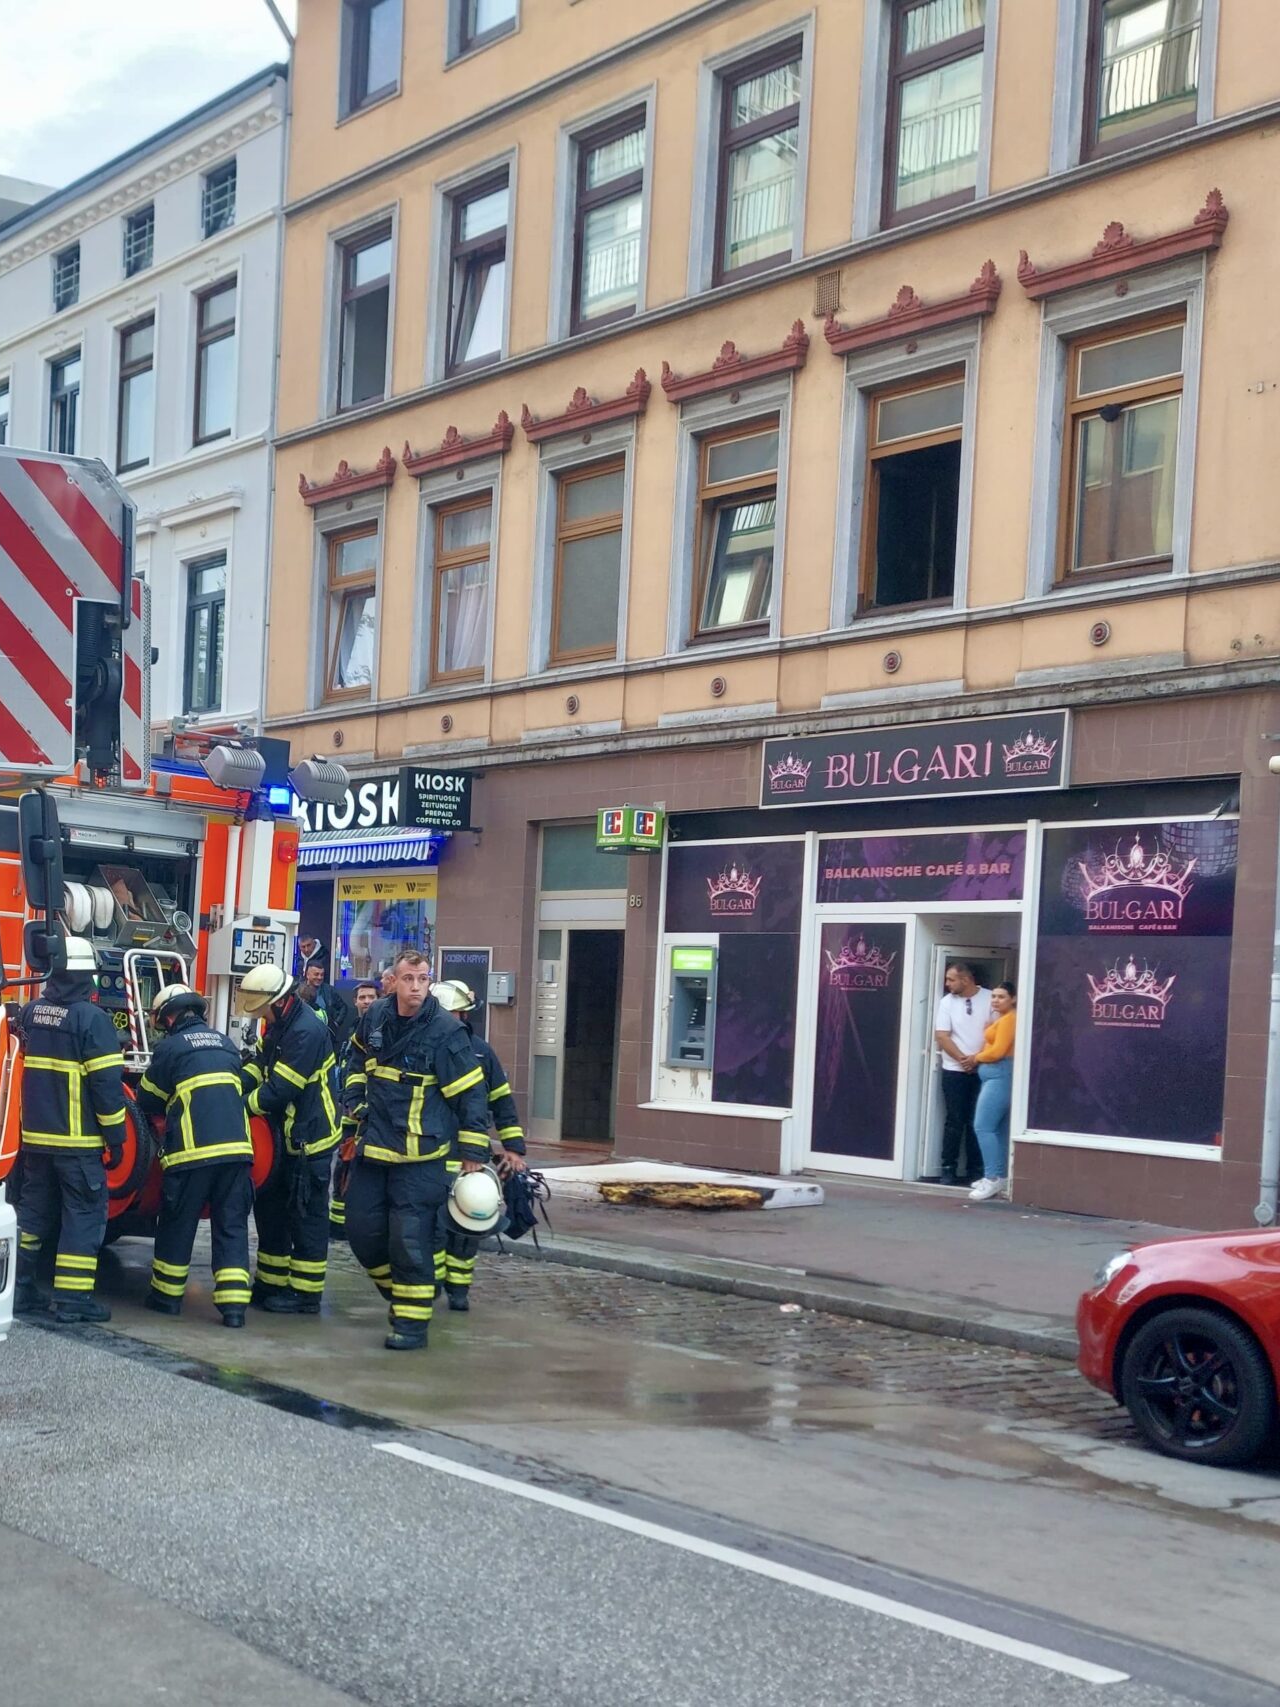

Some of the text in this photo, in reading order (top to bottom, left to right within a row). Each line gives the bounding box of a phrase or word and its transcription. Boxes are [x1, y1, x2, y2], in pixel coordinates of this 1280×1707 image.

[823, 739, 993, 789] BULGARI
[414, 773, 465, 793] KIOSK
[418, 793, 461, 802] SPIRITUOSEN
[421, 801, 458, 810] ZEITUNGEN
[415, 816, 440, 825] COFFEE
[825, 861, 1011, 879] BALKANISCHE CAFÉ & BAR
[629, 895, 642, 907] 86
[1085, 900, 1183, 920] BULGARI
[252, 934, 269, 950] HH
[243, 949, 275, 965] 2505
[32, 1004, 69, 1018] FEUERWEHR
[1091, 1003, 1165, 1020] BULGARI
[32, 1014, 62, 1026] HAMBURG
[183, 1032, 223, 1042] FEUERWEHR
[190, 1039, 223, 1048] HAMBURG
